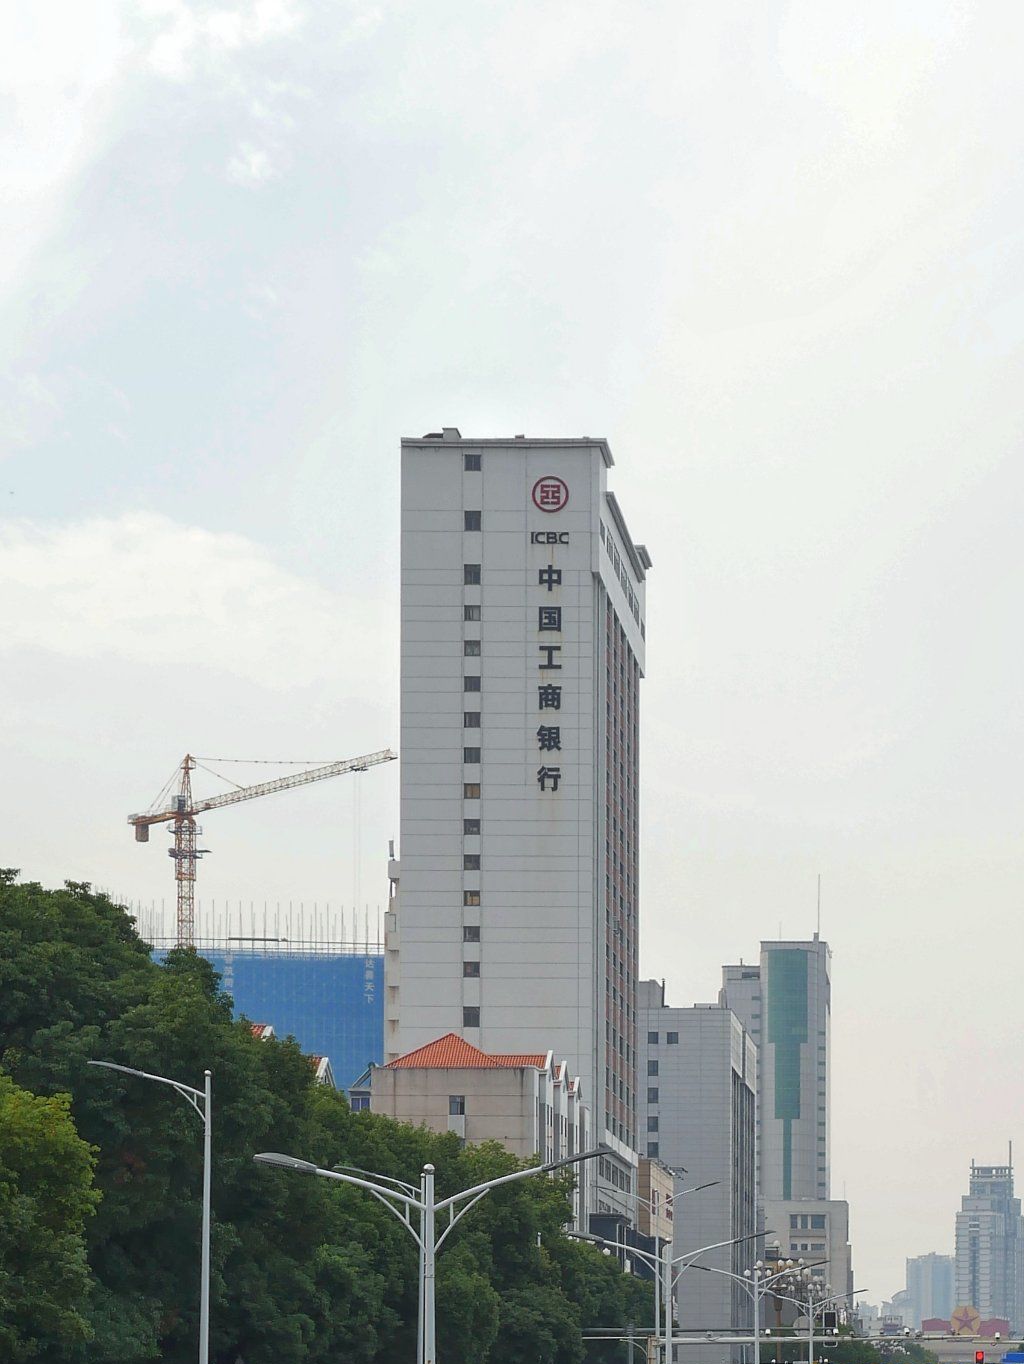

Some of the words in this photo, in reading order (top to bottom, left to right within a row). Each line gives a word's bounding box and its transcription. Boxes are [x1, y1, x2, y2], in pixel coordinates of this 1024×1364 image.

[530, 531, 569, 544] ICBC
[536, 564, 562, 792] 中国工商银行
